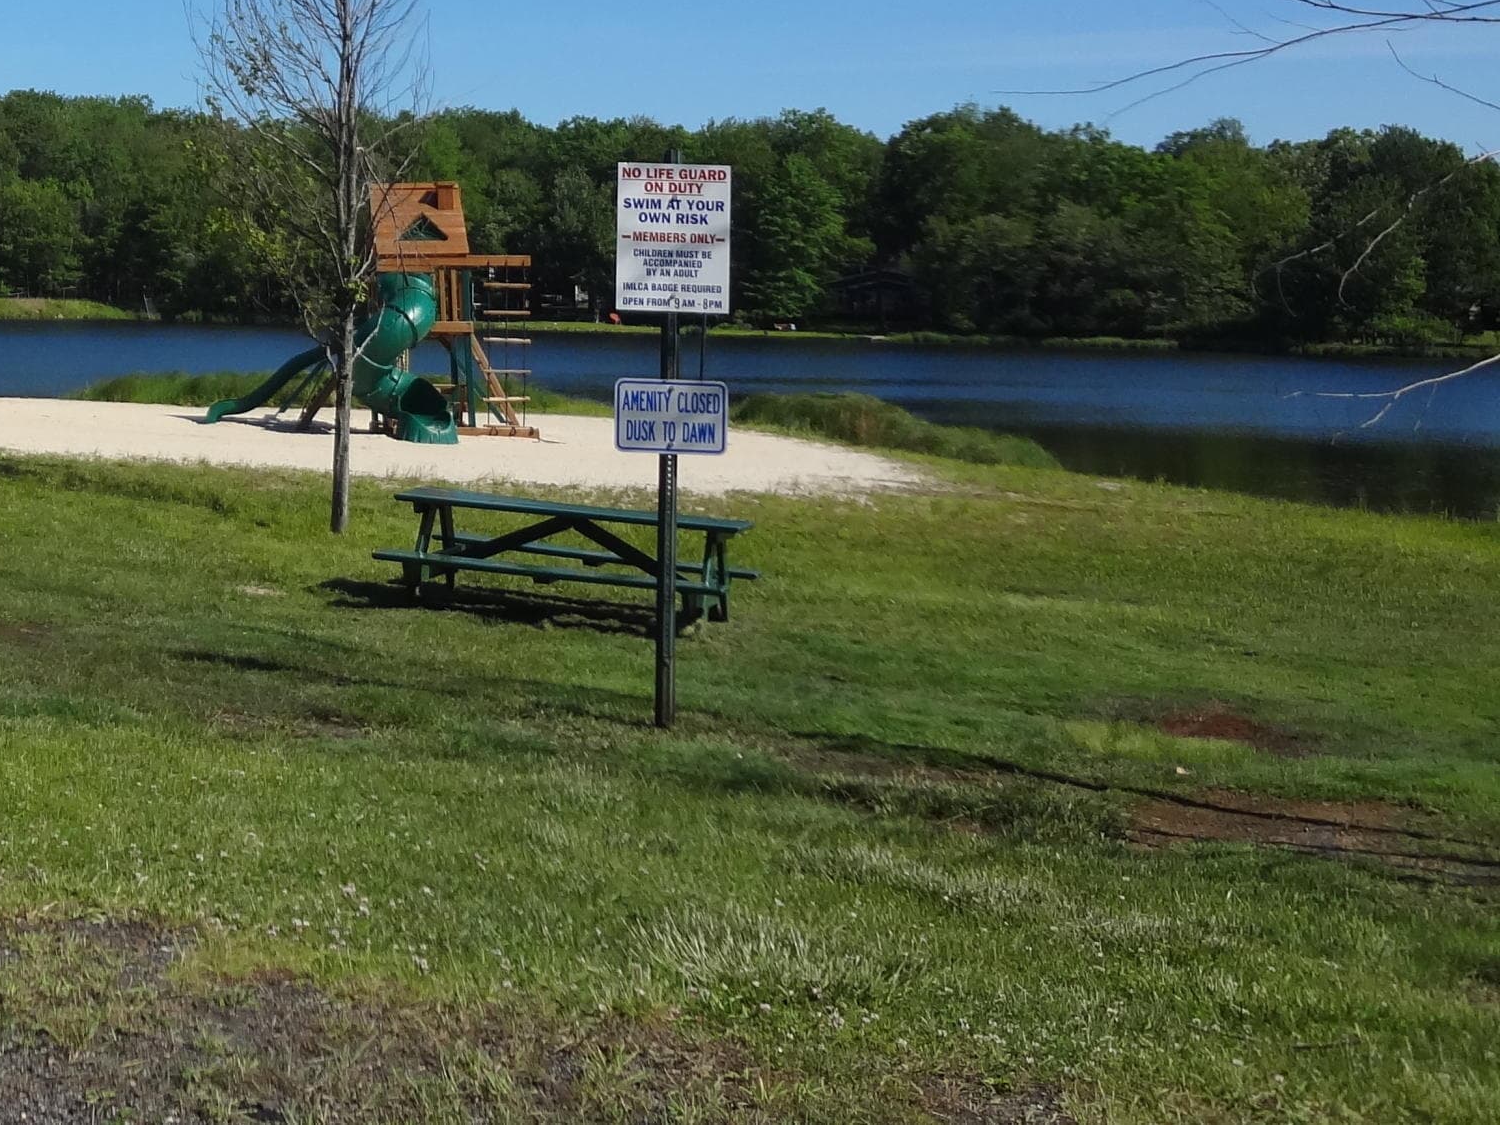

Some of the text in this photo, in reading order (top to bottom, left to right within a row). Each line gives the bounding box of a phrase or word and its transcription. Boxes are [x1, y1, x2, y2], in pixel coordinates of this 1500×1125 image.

[622, 167, 726, 180] NO LIFE GUARD
[645, 182, 703, 193] ON DUTY
[623, 198, 724, 211] SWIM AT YOUR
[639, 212, 708, 225] OWN RISK
[633, 249, 712, 259] CHILDREN MUST BE
[643, 259, 702, 268] ACCOMPANIED
[646, 268, 657, 276] BY
[673, 269, 698, 278] ADULT
[651, 283, 679, 292] BADGE
[681, 284, 722, 293] REQUIRED
[622, 297, 644, 306] OPEN
[647, 298, 670, 307] FROM
[622, 390, 720, 414] AMENITY CLOSED
[626, 420, 715, 443] DUSK TO DAWN
